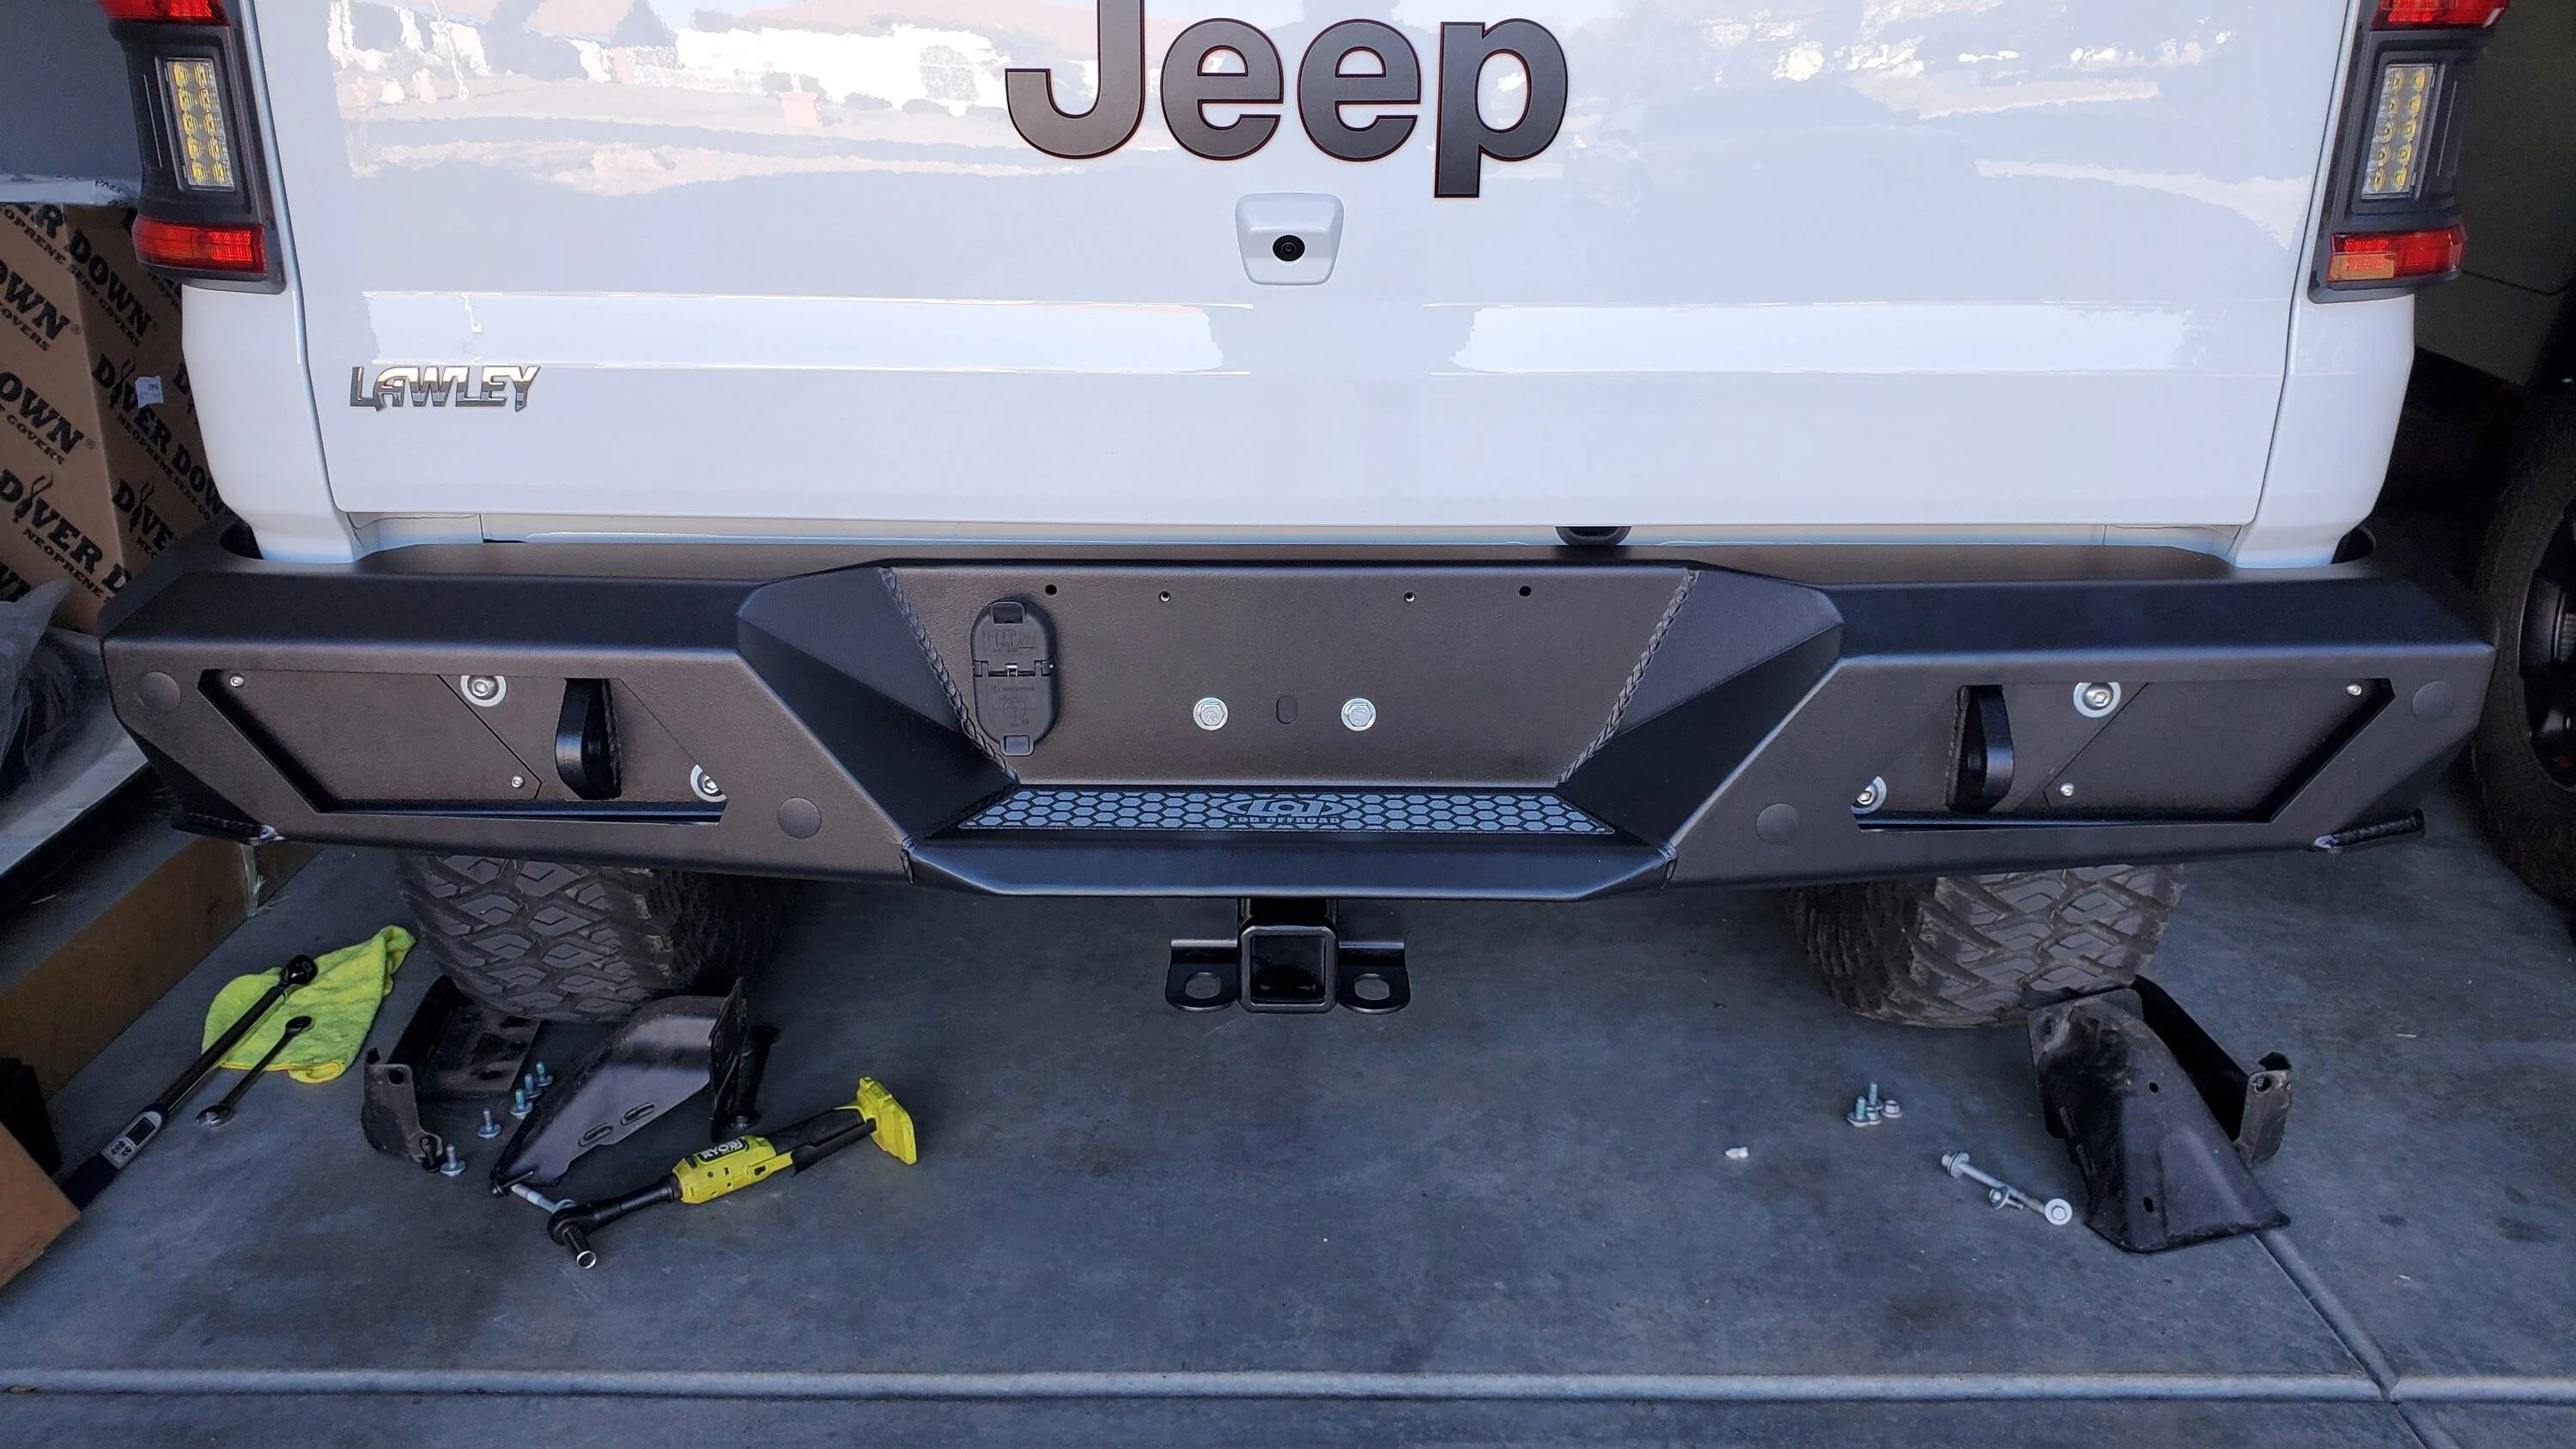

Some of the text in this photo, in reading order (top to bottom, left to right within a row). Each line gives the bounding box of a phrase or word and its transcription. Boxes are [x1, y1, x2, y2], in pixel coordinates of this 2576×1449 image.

[1005, 0, 1570, 198] Jeep
[0, 207, 66, 264] OPRENE
[0, 301, 51, 351] OVERS
[349, 366, 542, 412] LAWLEY
[7, 414, 65, 465] COVERS
[0, 468, 103, 574] DIVER
[23, 527, 105, 597] NEOPRENE
